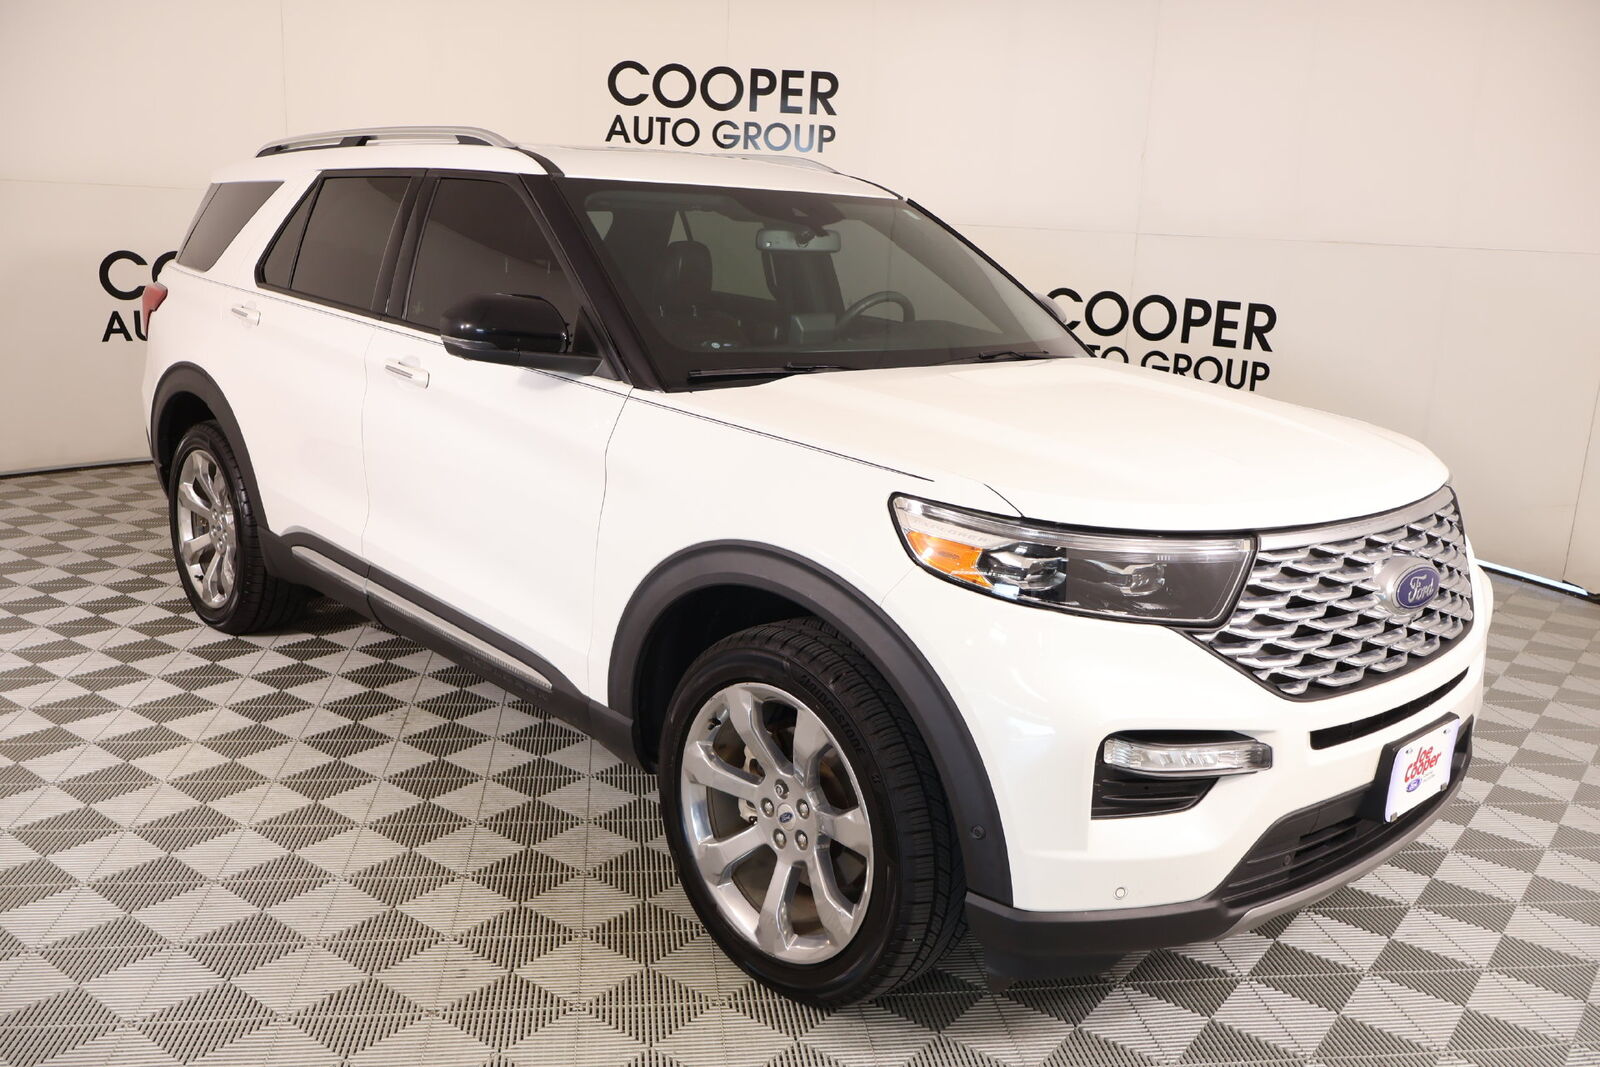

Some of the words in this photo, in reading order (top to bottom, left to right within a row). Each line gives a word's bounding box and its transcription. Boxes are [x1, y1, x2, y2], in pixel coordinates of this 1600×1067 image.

[607, 60, 839, 116] COOPER
[605, 114, 700, 147] AUTO
[712, 120, 836, 153] GROUP
[1407, 574, 1434, 603] Ford
[1404, 752, 1442, 783] Cooper
[1413, 746, 1434, 767] Joe
